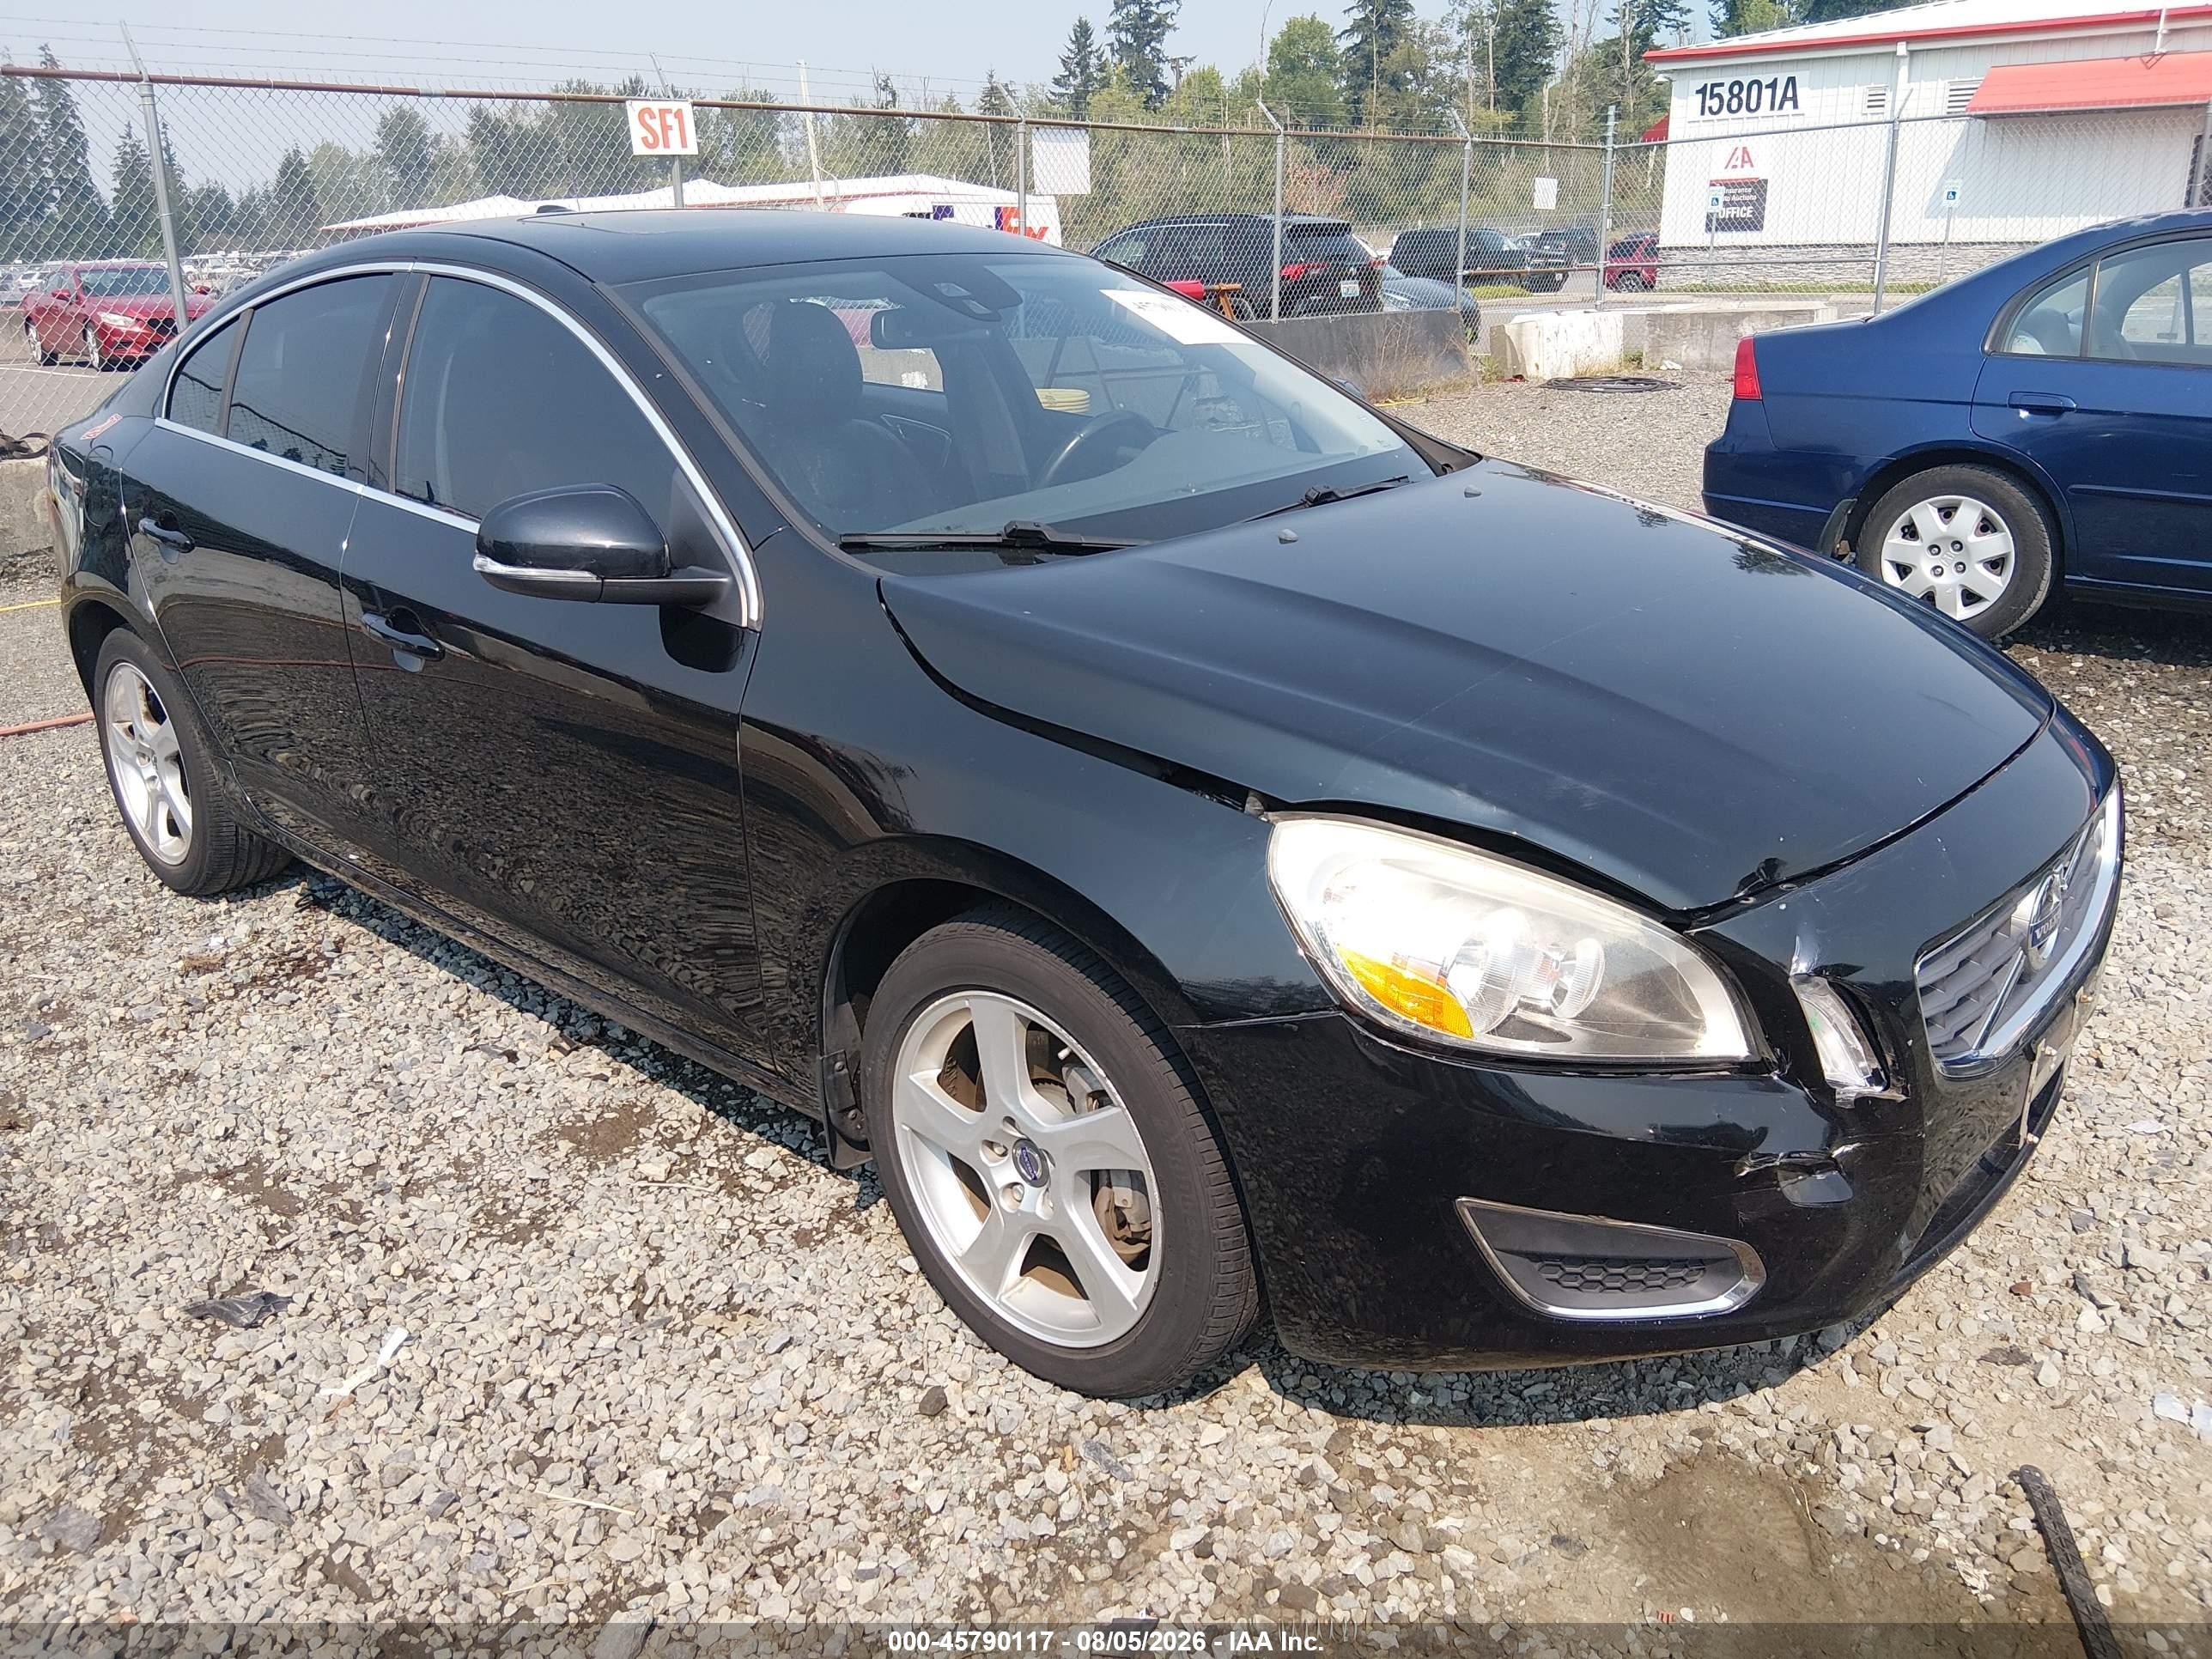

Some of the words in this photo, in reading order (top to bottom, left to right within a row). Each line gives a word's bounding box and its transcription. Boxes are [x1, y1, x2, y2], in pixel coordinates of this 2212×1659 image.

[1695, 76, 1799, 116] 15801A
[638, 106, 688, 149] SF1
[1718, 206, 1754, 219] OFFICE
